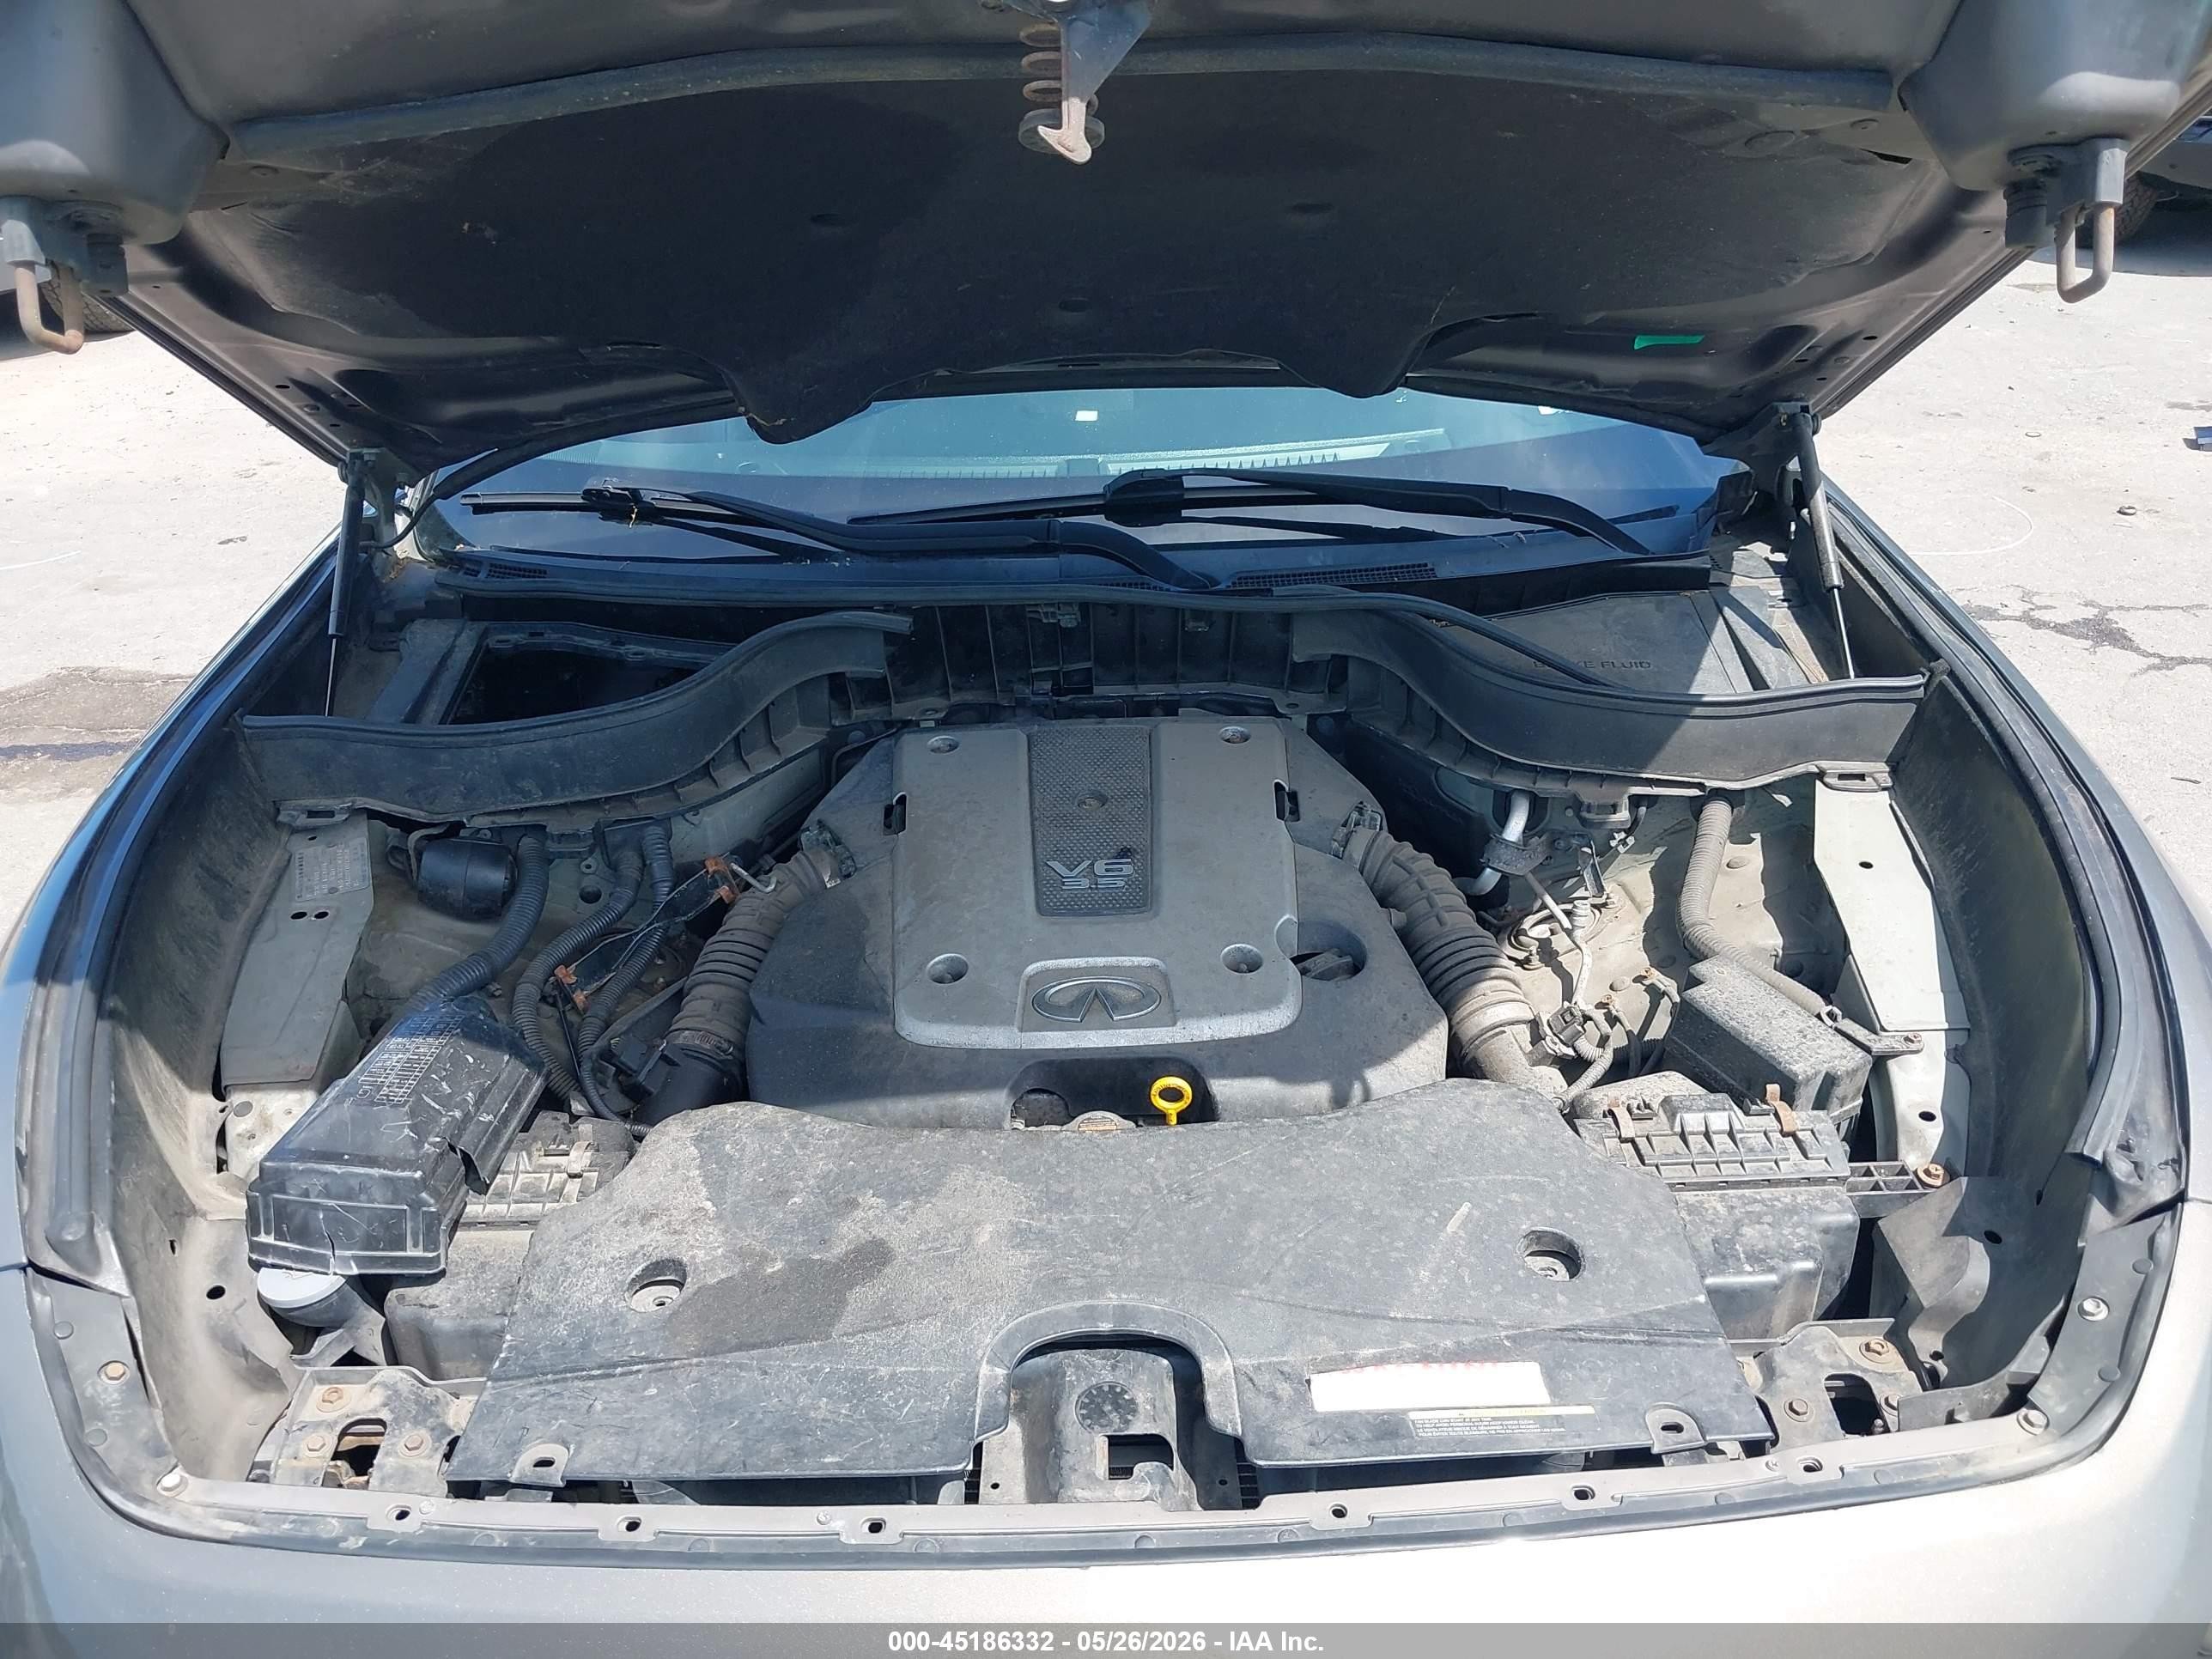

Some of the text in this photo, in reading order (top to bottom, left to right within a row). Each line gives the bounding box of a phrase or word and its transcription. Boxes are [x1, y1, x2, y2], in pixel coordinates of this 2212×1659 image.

[1601, 660, 1651, 669] FLUID
[1046, 859, 1133, 877] V6
[1061, 878, 1127, 890] 3.5
